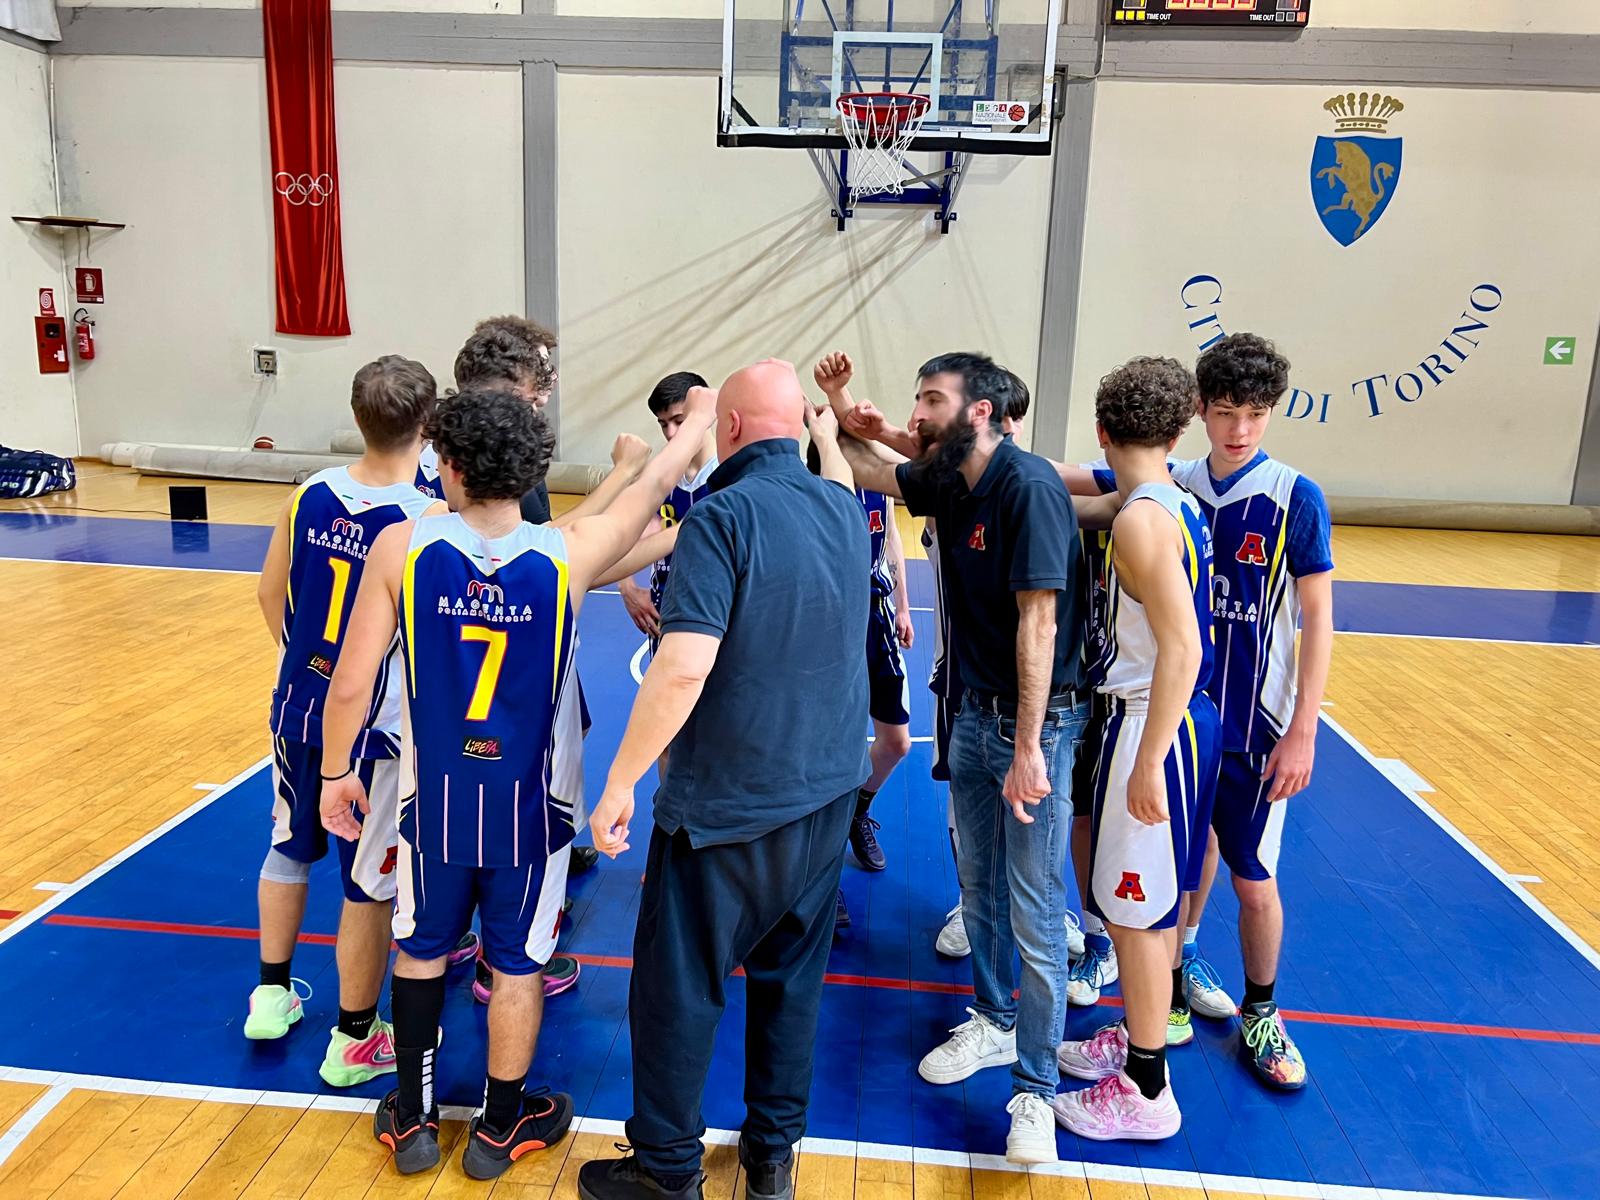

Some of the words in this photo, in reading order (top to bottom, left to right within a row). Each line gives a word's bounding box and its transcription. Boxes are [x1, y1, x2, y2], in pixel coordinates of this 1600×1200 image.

[1180, 274, 1226, 352] CIT
[1283, 388, 1332, 423] DI
[1352, 284, 1502, 418] TORINO
[308, 528, 368, 555] MAGENT
[323, 556, 352, 646] 1
[438, 596, 533, 615] MAGENTA
[460, 624, 509, 722] 7
